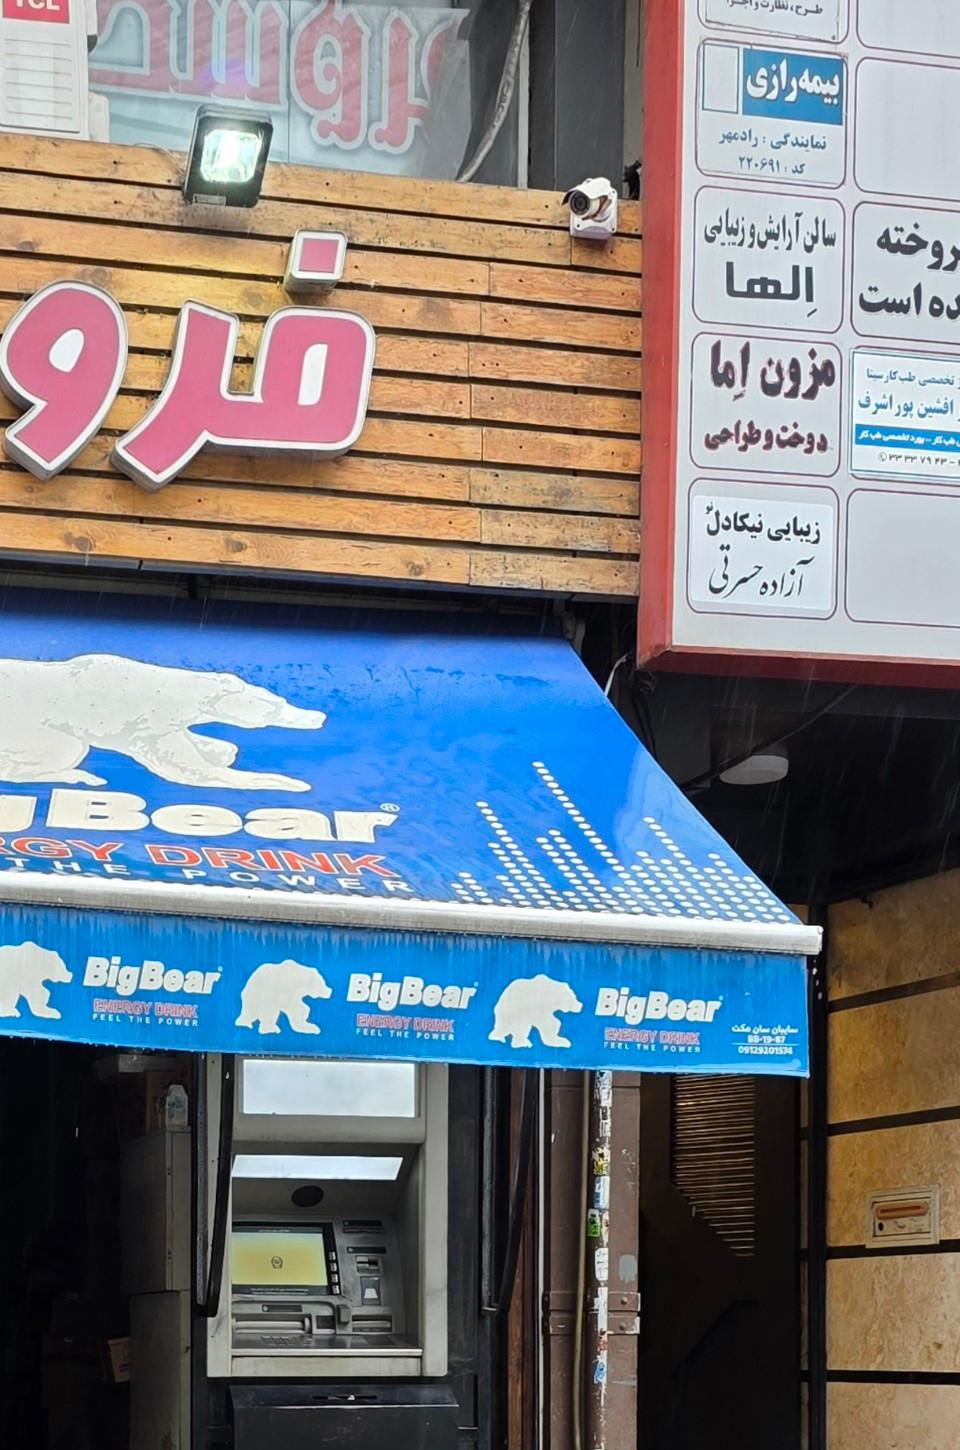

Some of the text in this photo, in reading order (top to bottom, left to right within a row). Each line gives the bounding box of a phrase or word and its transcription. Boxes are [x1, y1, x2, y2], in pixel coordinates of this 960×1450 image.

[746, 58, 840, 105] بیمه رازی
[704, 207, 837, 254] سالن آرایش و زیبایی
[876, 222, 960, 272] روخته
[859, 281, 960, 320] ده است
[760, 347, 836, 401] مزون
[704, 419, 828, 455] دوخت و طراحی
[767, 515, 821, 544] زیبایی
[759, 556, 815, 597] آزاده
[5, 857, 131, 875] THE
[181, 868, 416, 893] POWER
[144, 843, 402, 878] DRINK
[82, 956, 222, 996] BigBear
[347, 972, 477, 1012] BigBear
[93, 998, 199, 1018] ENERGY DRINK
[93, 1013, 198, 1027] FEEL THE POWER
[595, 987, 722, 1025] BigBear
